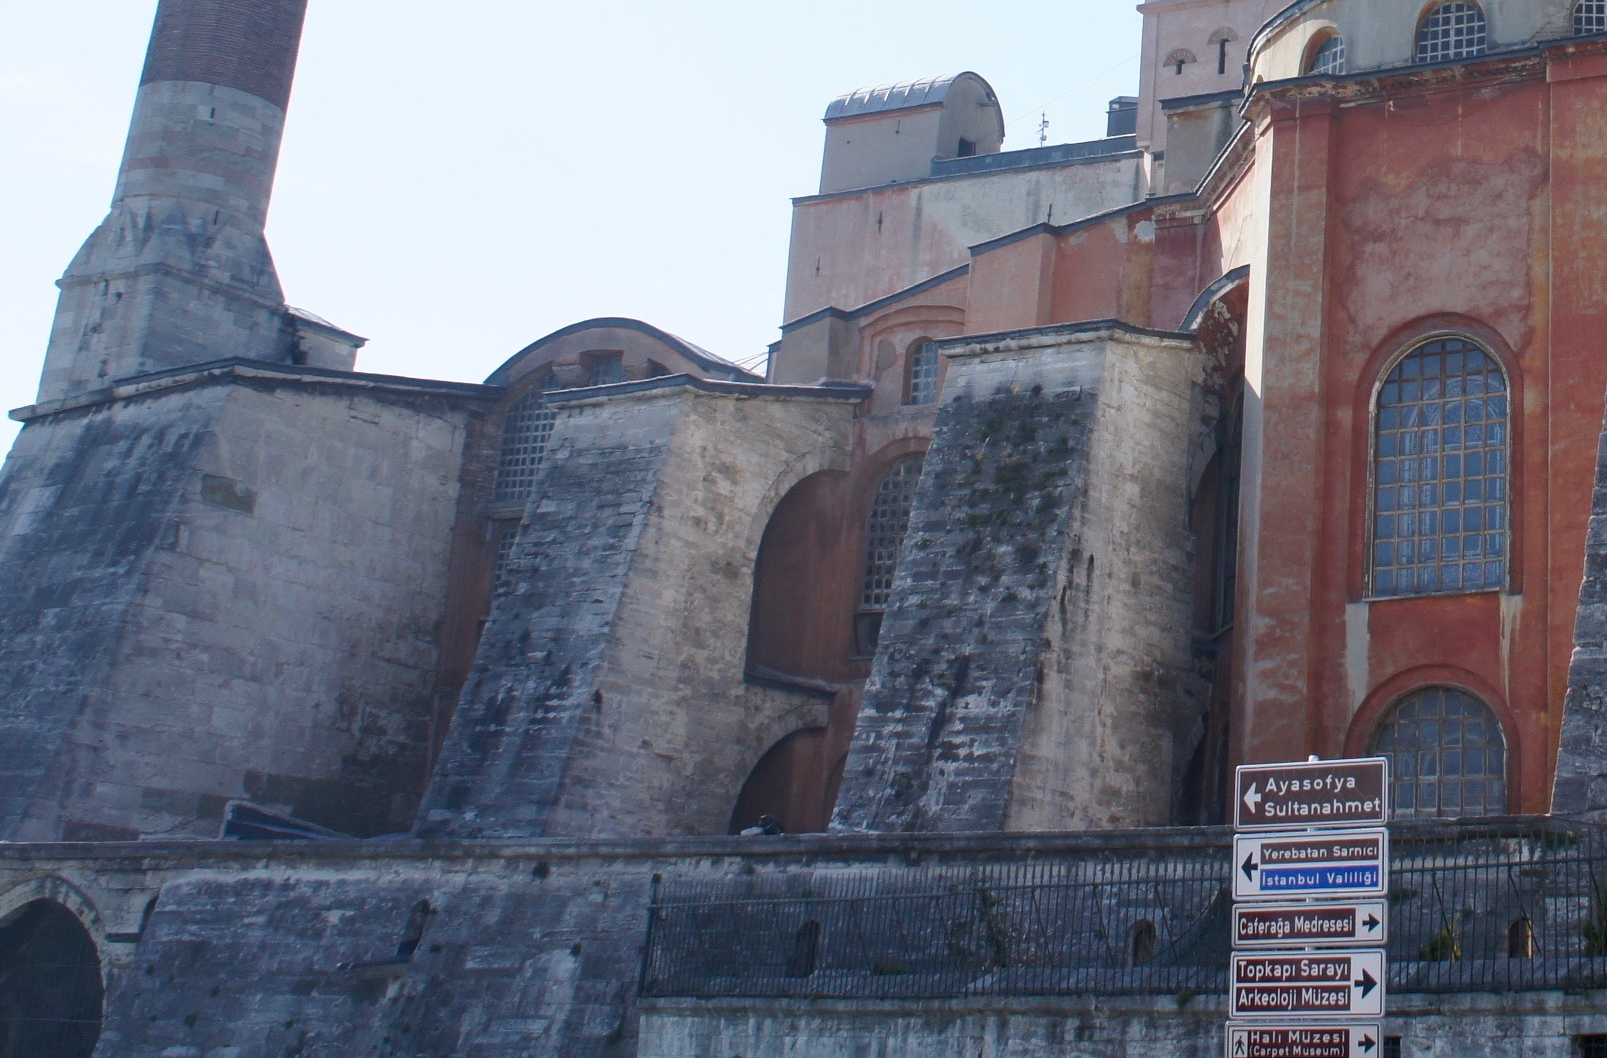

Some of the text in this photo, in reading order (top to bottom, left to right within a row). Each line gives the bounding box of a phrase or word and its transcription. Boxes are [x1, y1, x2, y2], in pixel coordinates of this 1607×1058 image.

[1265, 774, 1356, 795] Ayasofya
[1264, 797, 1380, 817] Sultanahmet
[1263, 845, 1377, 860] Yerebatan Sarnıcı
[1262, 870, 1377, 886] İstanbul Valiliği
[1239, 915, 1353, 938] Caferağa Medresesi
[1238, 959, 1348, 981] Topkapı Sarayı
[1238, 987, 1349, 1010] Arkeoloji Müzesi
[1250, 1029, 1346, 1044] Halı Müzesi
[1249, 1044, 1345, 1058] (Carpet Museum)
